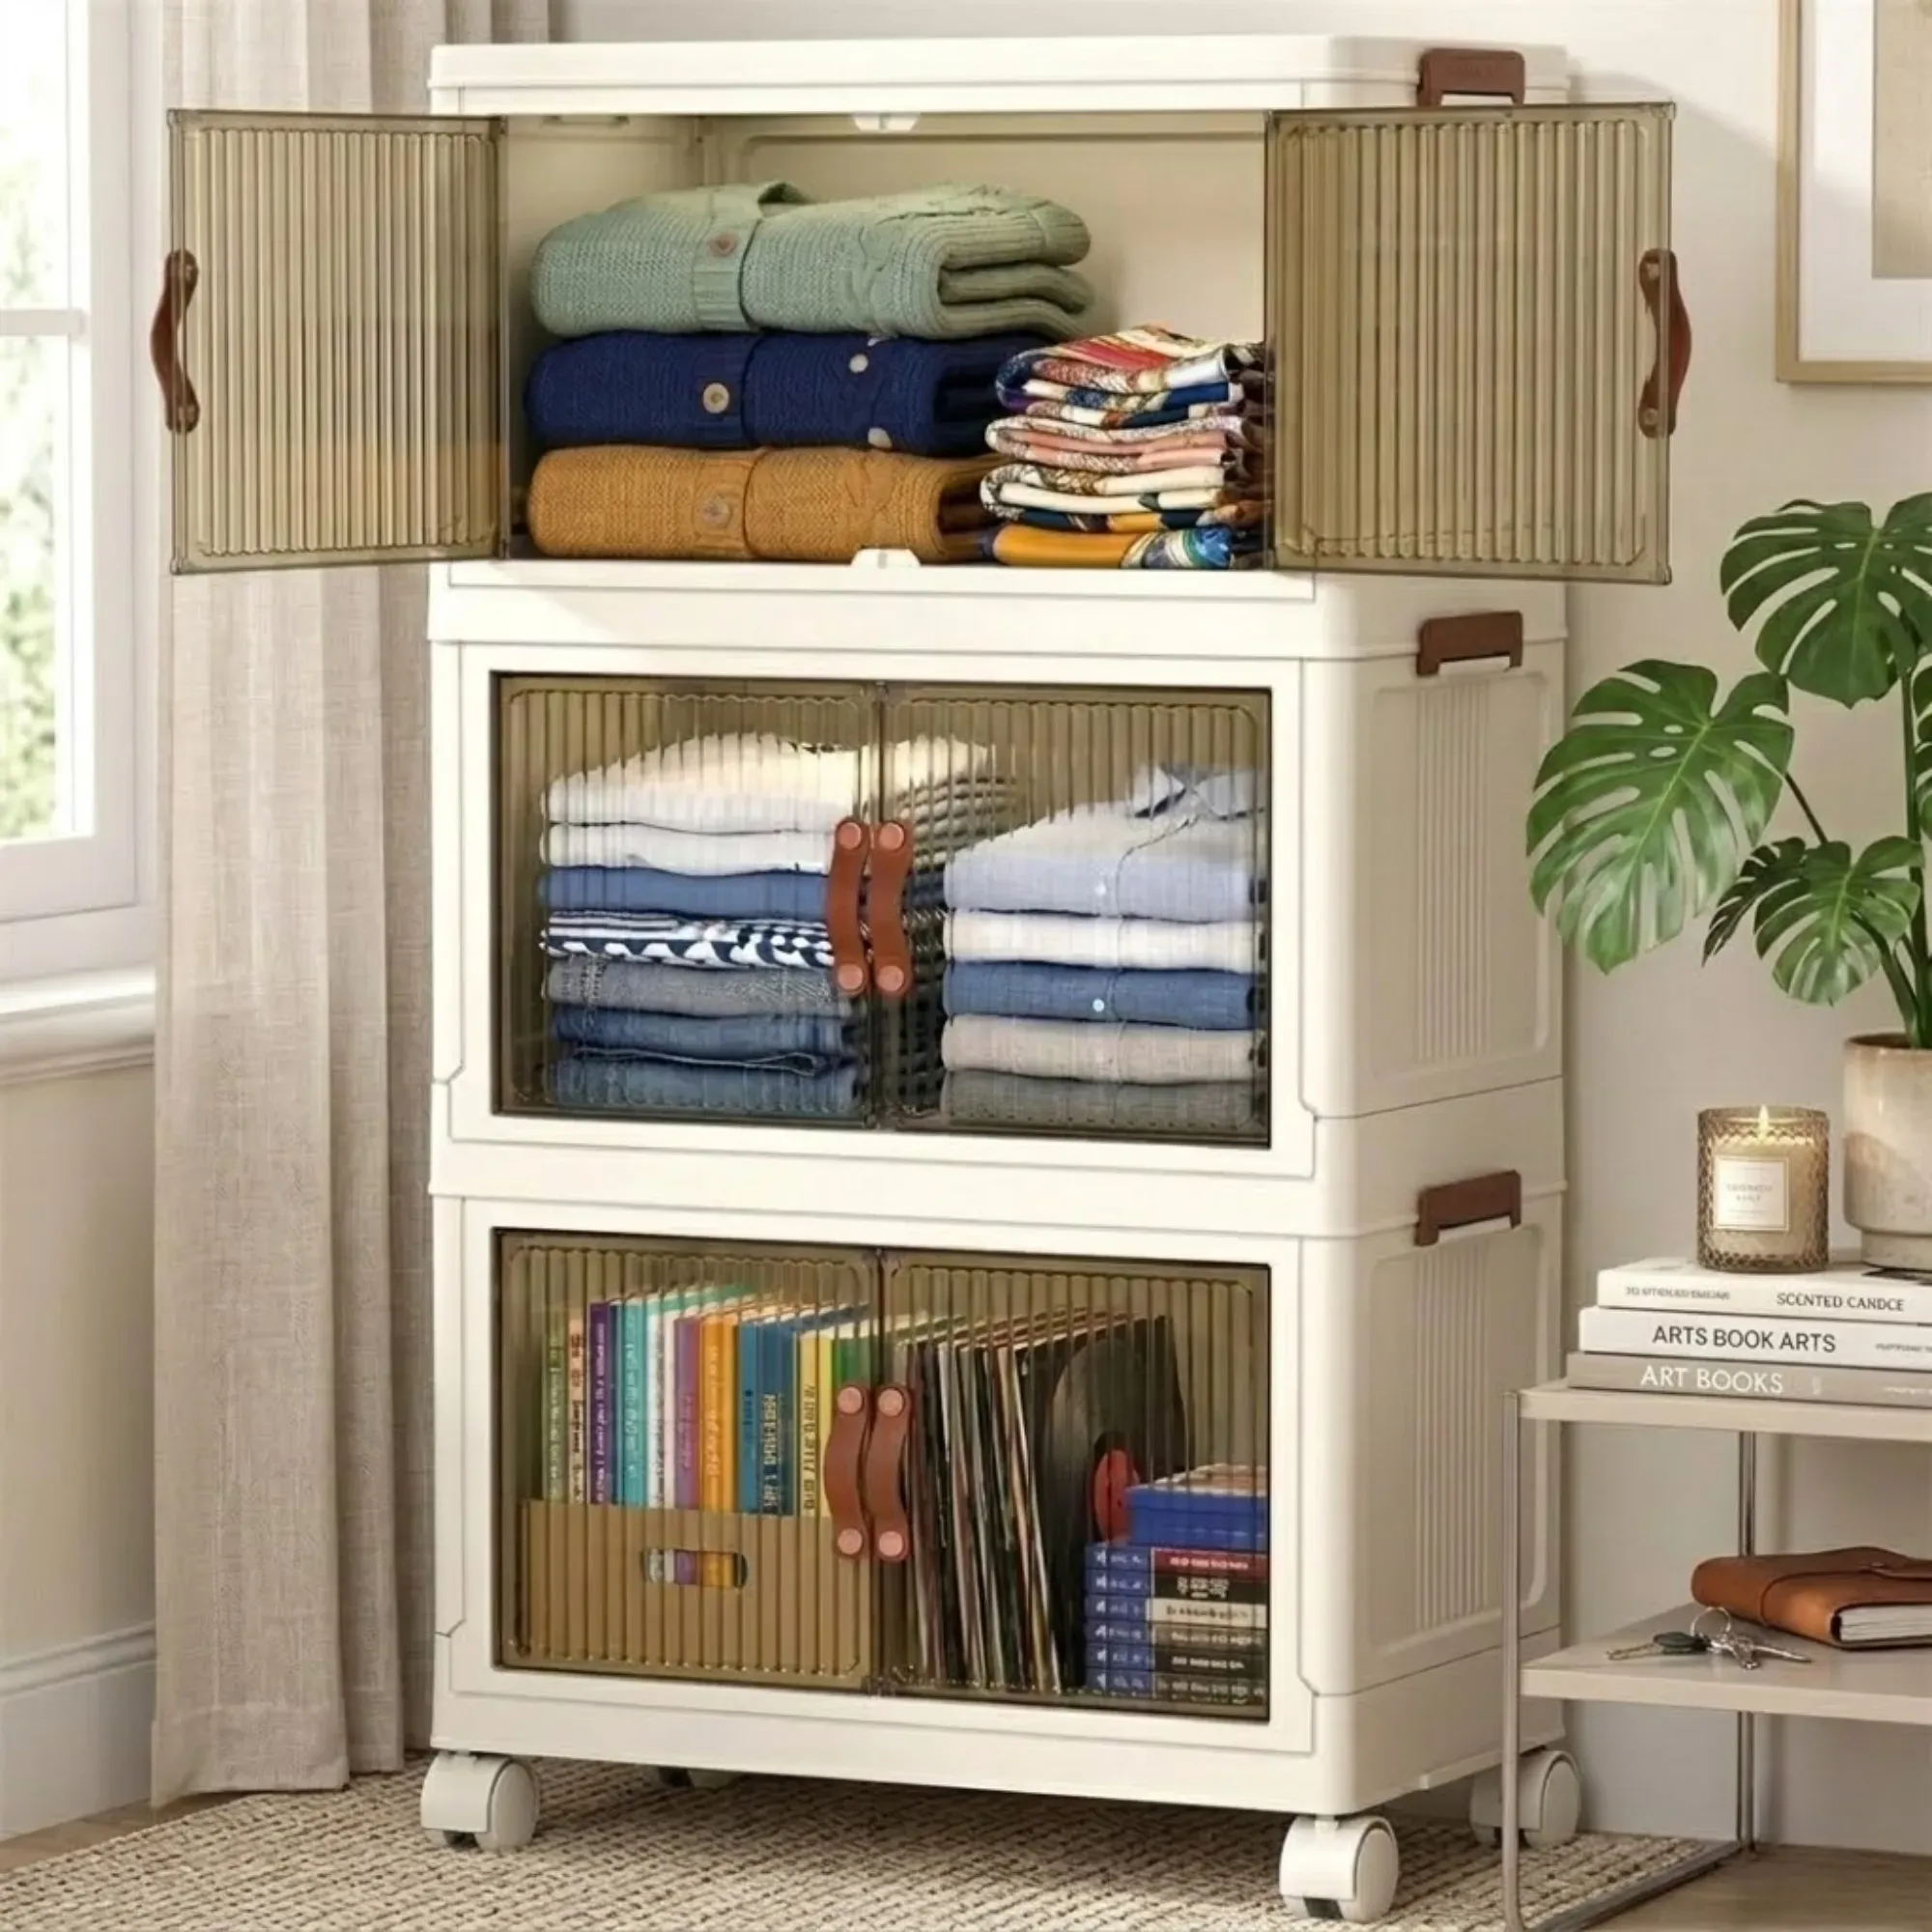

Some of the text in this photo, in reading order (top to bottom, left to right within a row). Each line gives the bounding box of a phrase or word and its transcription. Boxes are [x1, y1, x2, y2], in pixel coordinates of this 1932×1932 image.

[1776, 1293, 1843, 1308] SCENTED
[1652, 1325, 1836, 1352] ARTS BOOK ARTS
[1640, 1364, 1689, 1387] ART
[1696, 1368, 1783, 1394] BOOKS
